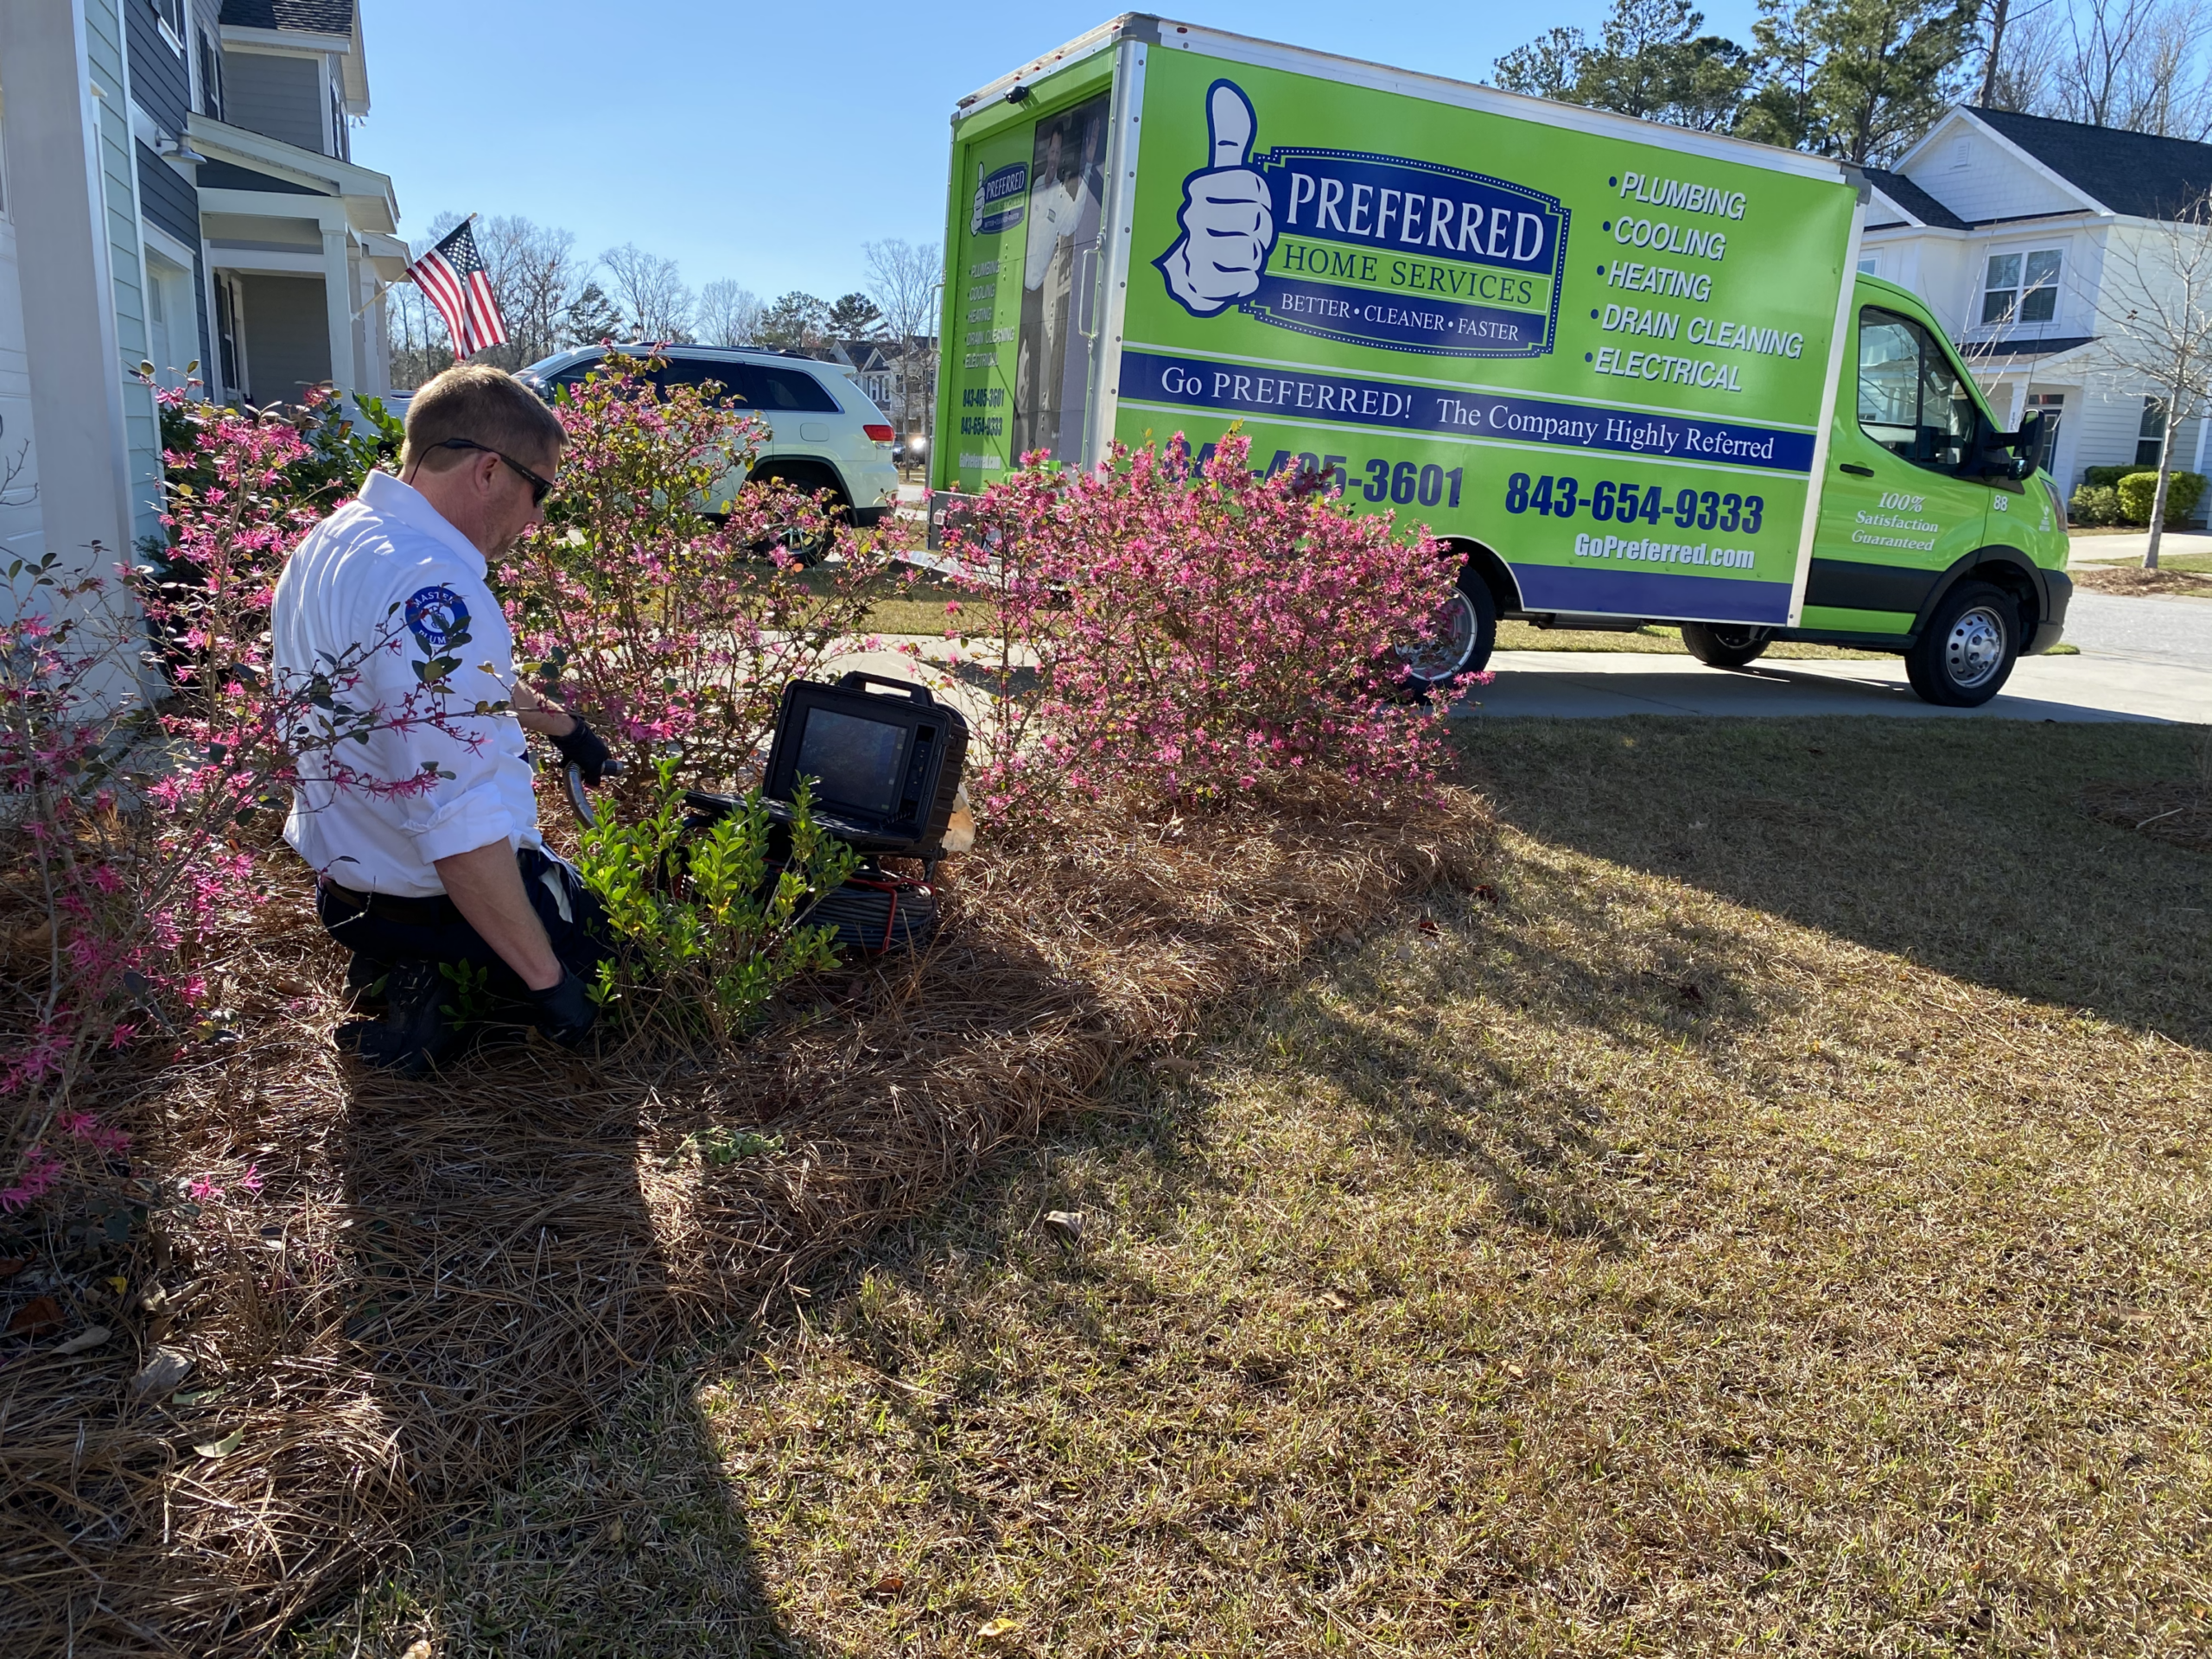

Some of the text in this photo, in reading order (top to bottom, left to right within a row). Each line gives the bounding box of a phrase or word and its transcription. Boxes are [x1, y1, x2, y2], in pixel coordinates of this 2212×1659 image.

[986, 170, 1025, 200] PREFERRED
[1619, 171, 1747, 220] PLUMBING
[1287, 172, 1545, 262] PREFERRED
[1614, 215, 1726, 261] COOLING
[971, 260, 1000, 278] PLUMBING
[1282, 245, 1534, 305] HOME SERVICES
[1607, 260, 1713, 302] HEATING
[969, 283, 995, 302] COOLING
[969, 307, 993, 324] HEATING
[1281, 293, 1520, 343] BETTER CLEANER FASTER
[966, 326, 1015, 346] DRAIN CLEANING
[1602, 303, 1804, 359] DRAIN CLEANING
[964, 352, 999, 369] ELECTRICAL
[1594, 346, 1743, 392] ELECTRICAL
[963, 388, 1005, 409] 843-405-3601
[1161, 366, 1775, 461] Go PREFERRED! The Company Highly Referred
[960, 416, 1003, 436] 843-654-9333
[1163, 439, 1764, 535] 84-405-3601 843-654-9333
[1878, 492, 1927, 513] 100%
[1993, 494, 2008, 512] 88
[1855, 510, 1939, 533] Satisfaction
[1573, 532, 1755, 570] GoPreferred.com
[1851, 529, 1936, 552] Guaranteed
